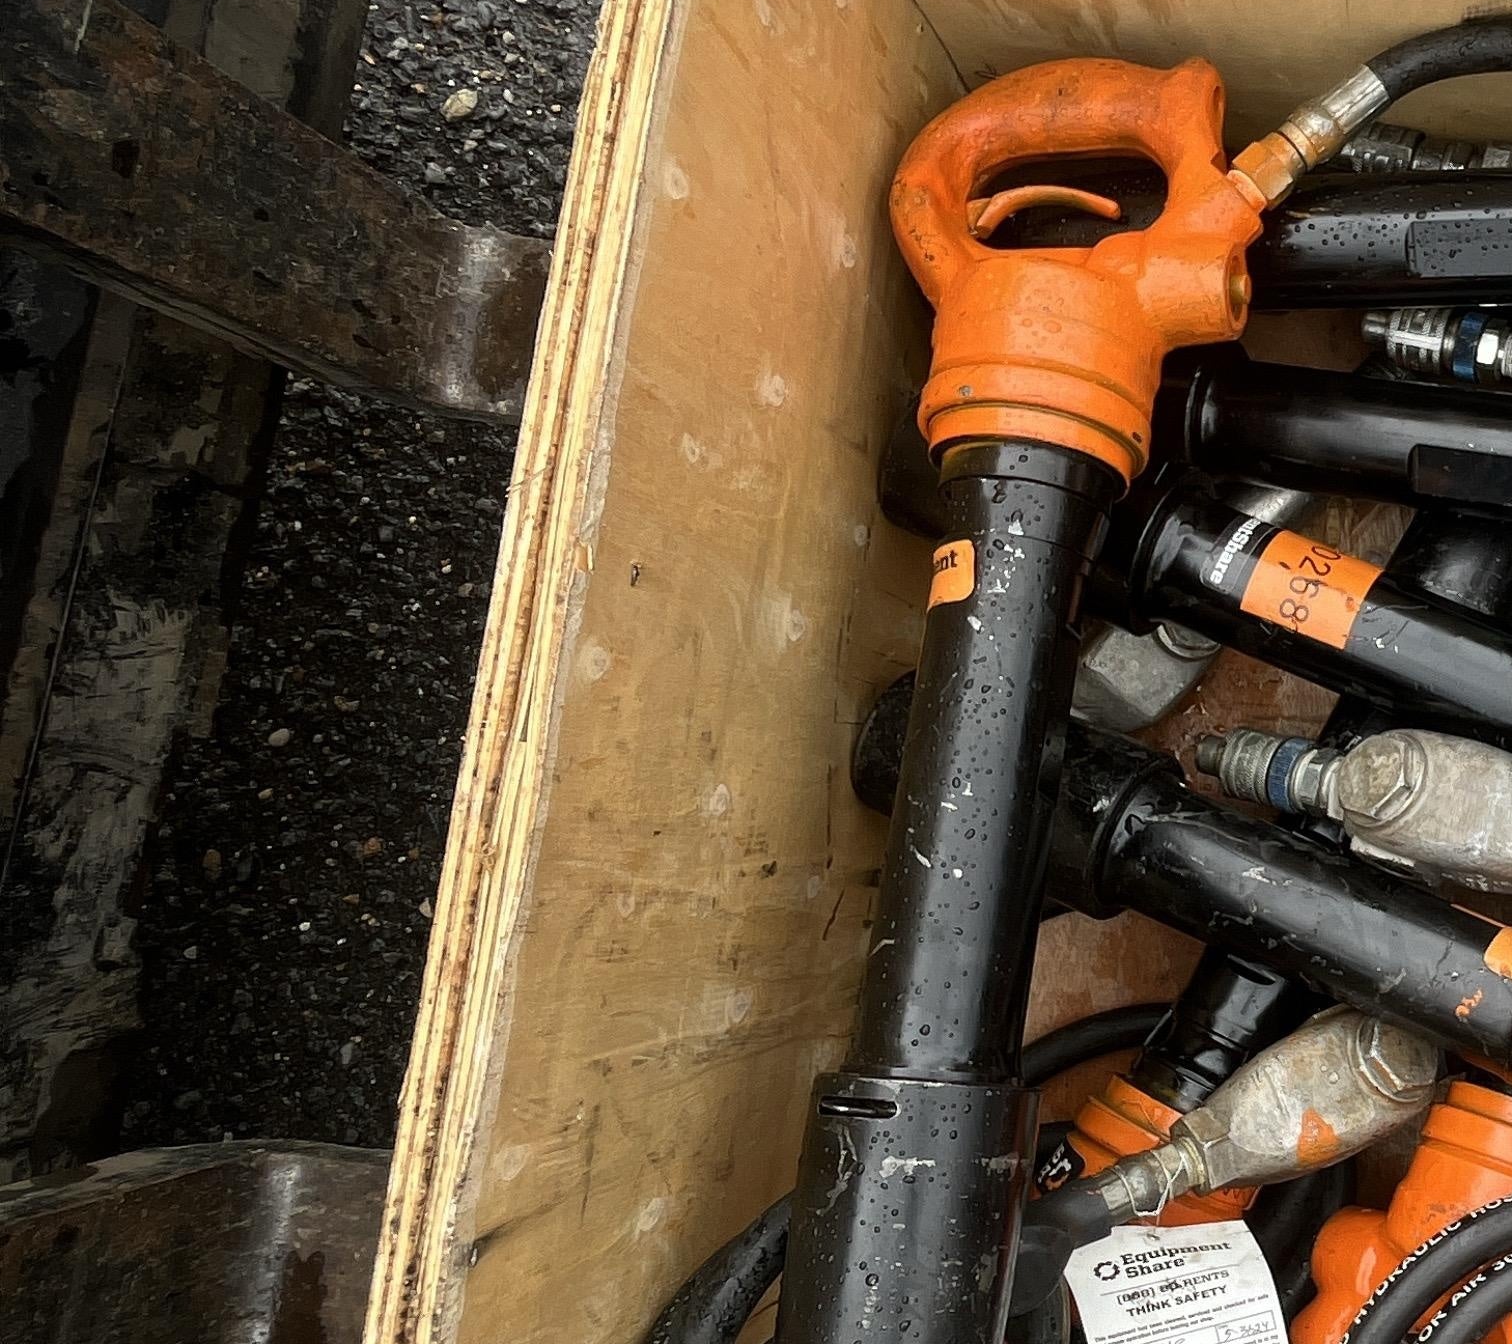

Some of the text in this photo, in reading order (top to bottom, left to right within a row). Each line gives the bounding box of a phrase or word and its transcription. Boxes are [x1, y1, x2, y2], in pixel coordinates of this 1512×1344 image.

[1120, 1241, 1232, 1266] Equipment
[1125, 1258, 1185, 1279] Share
[1126, 1285, 1228, 1317] THINK SAFETY
[1451, 1274, 1487, 1307] AIR
